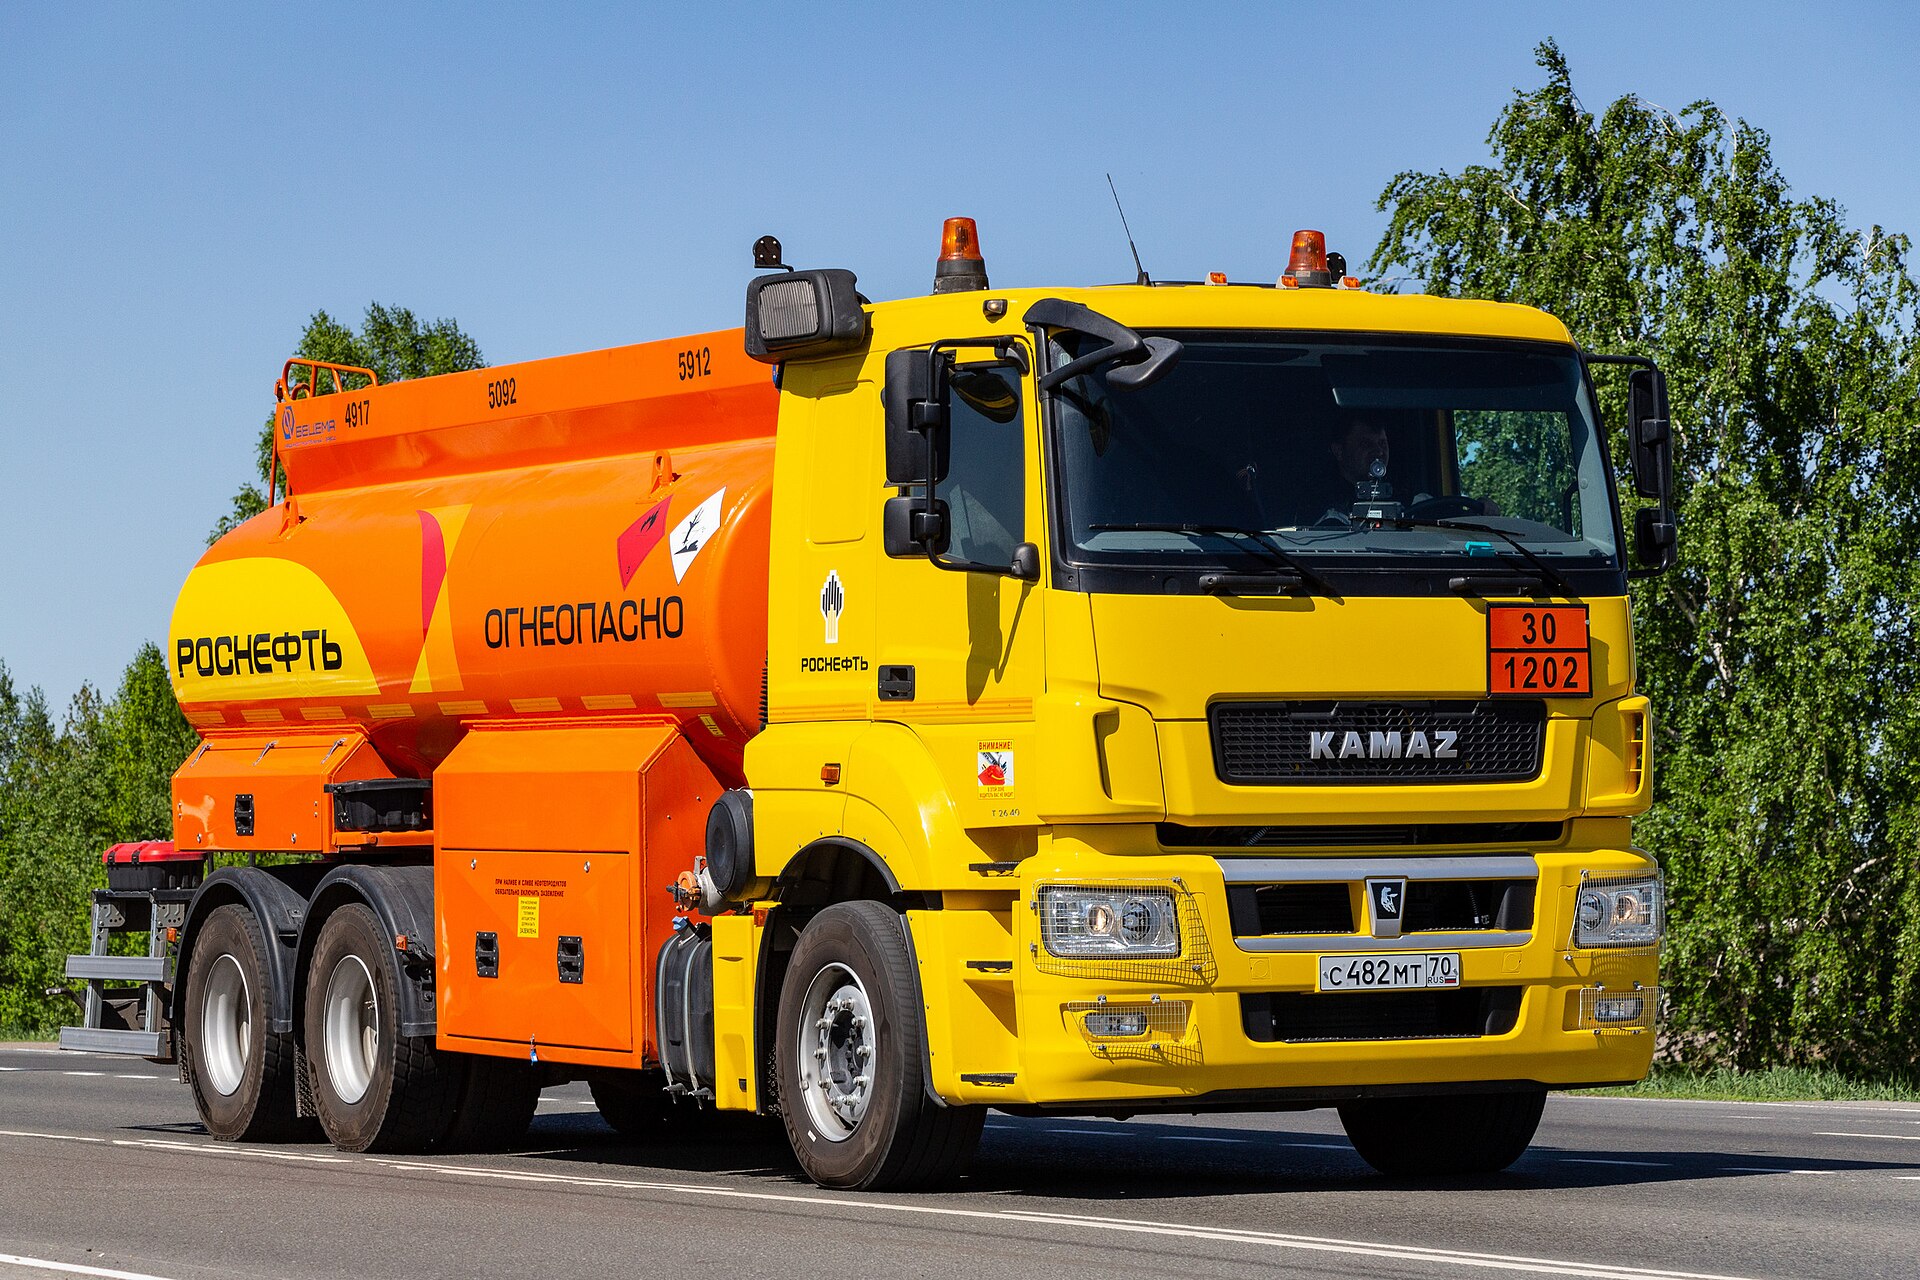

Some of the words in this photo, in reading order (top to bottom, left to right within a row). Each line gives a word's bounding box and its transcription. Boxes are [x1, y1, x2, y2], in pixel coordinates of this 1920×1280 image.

[678, 346, 711, 381] 5912
[488, 377, 517, 409] 5092
[345, 399, 370, 428] 4917
[484, 595, 684, 649] ОГНЕОПАСНО
[1521, 612, 1557, 646] 30
[177, 629, 343, 678] РОСНЕФТЬ
[801, 656, 869, 673] РОСНЕФТЬ
[1503, 655, 1579, 690] 1202
[979, 741, 1013, 750] ВНИМАНИЕ!
[1309, 730, 1458, 759] KAMAZ
[1329, 959, 1422, 986] С482МТ
[1427, 976, 1445, 984] RUS
[1429, 956, 1451, 977] 70
